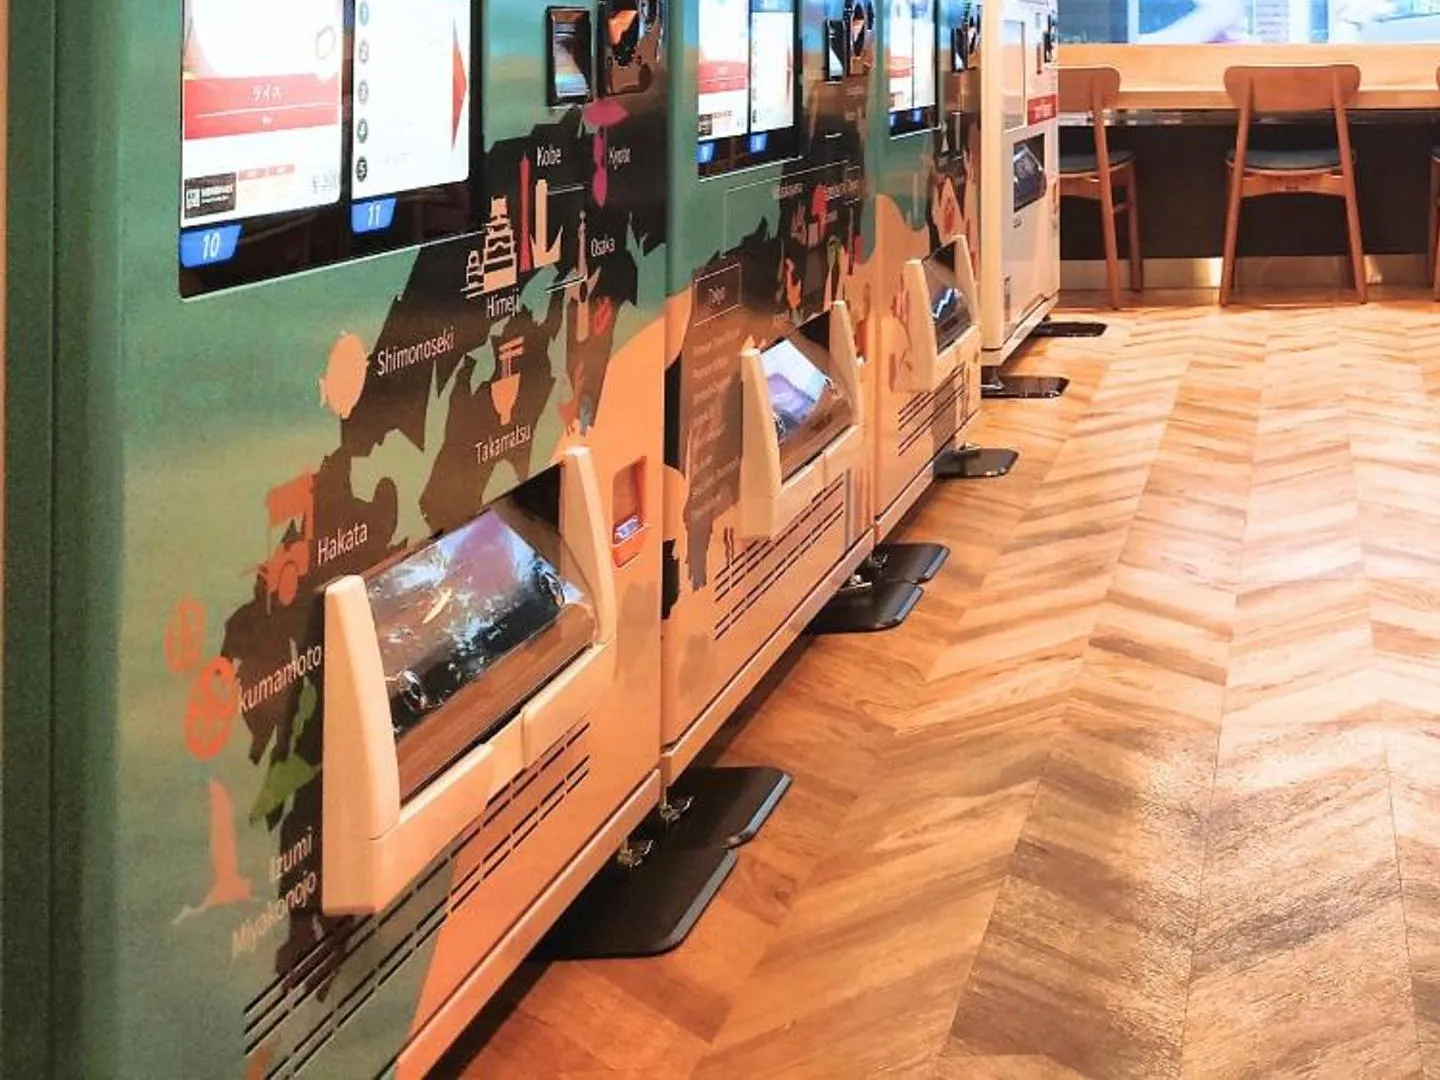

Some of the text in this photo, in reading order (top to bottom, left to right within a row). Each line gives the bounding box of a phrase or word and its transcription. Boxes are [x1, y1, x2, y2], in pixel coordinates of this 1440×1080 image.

[536, 144, 562, 168] Kobe
[366, 203, 382, 227] 11
[202, 231, 221, 260] 10
[590, 234, 616, 257] Osaka
[486, 288, 522, 319] Himeji
[377, 325, 456, 377] Shimonoseki
[475, 424, 532, 465] Takamatsu
[317, 521, 369, 566] Hakata
[269, 825, 313, 885] Izumi
